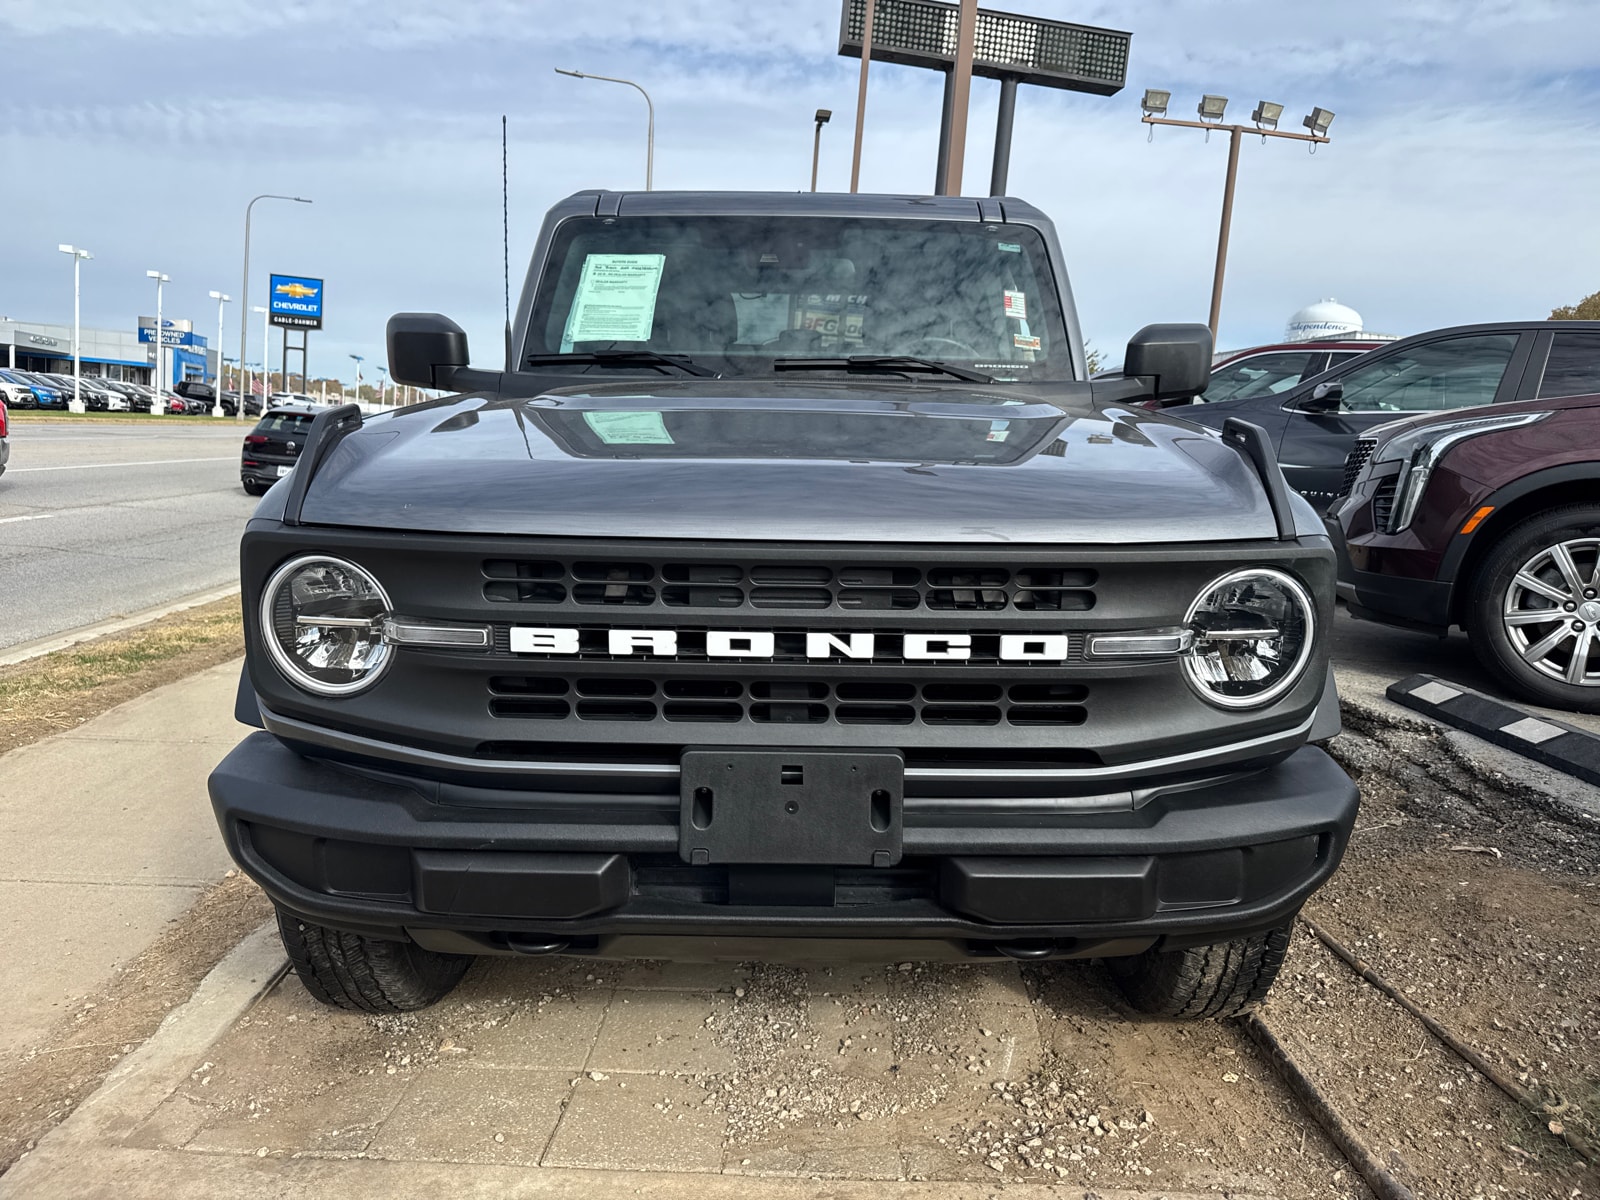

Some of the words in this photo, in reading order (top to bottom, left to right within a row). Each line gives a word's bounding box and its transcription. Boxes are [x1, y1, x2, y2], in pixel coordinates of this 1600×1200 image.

[273, 301, 319, 312] CHEVROLET
[148, 335, 181, 344] VEICLES
[509, 626, 1069, 661] BRONCO
